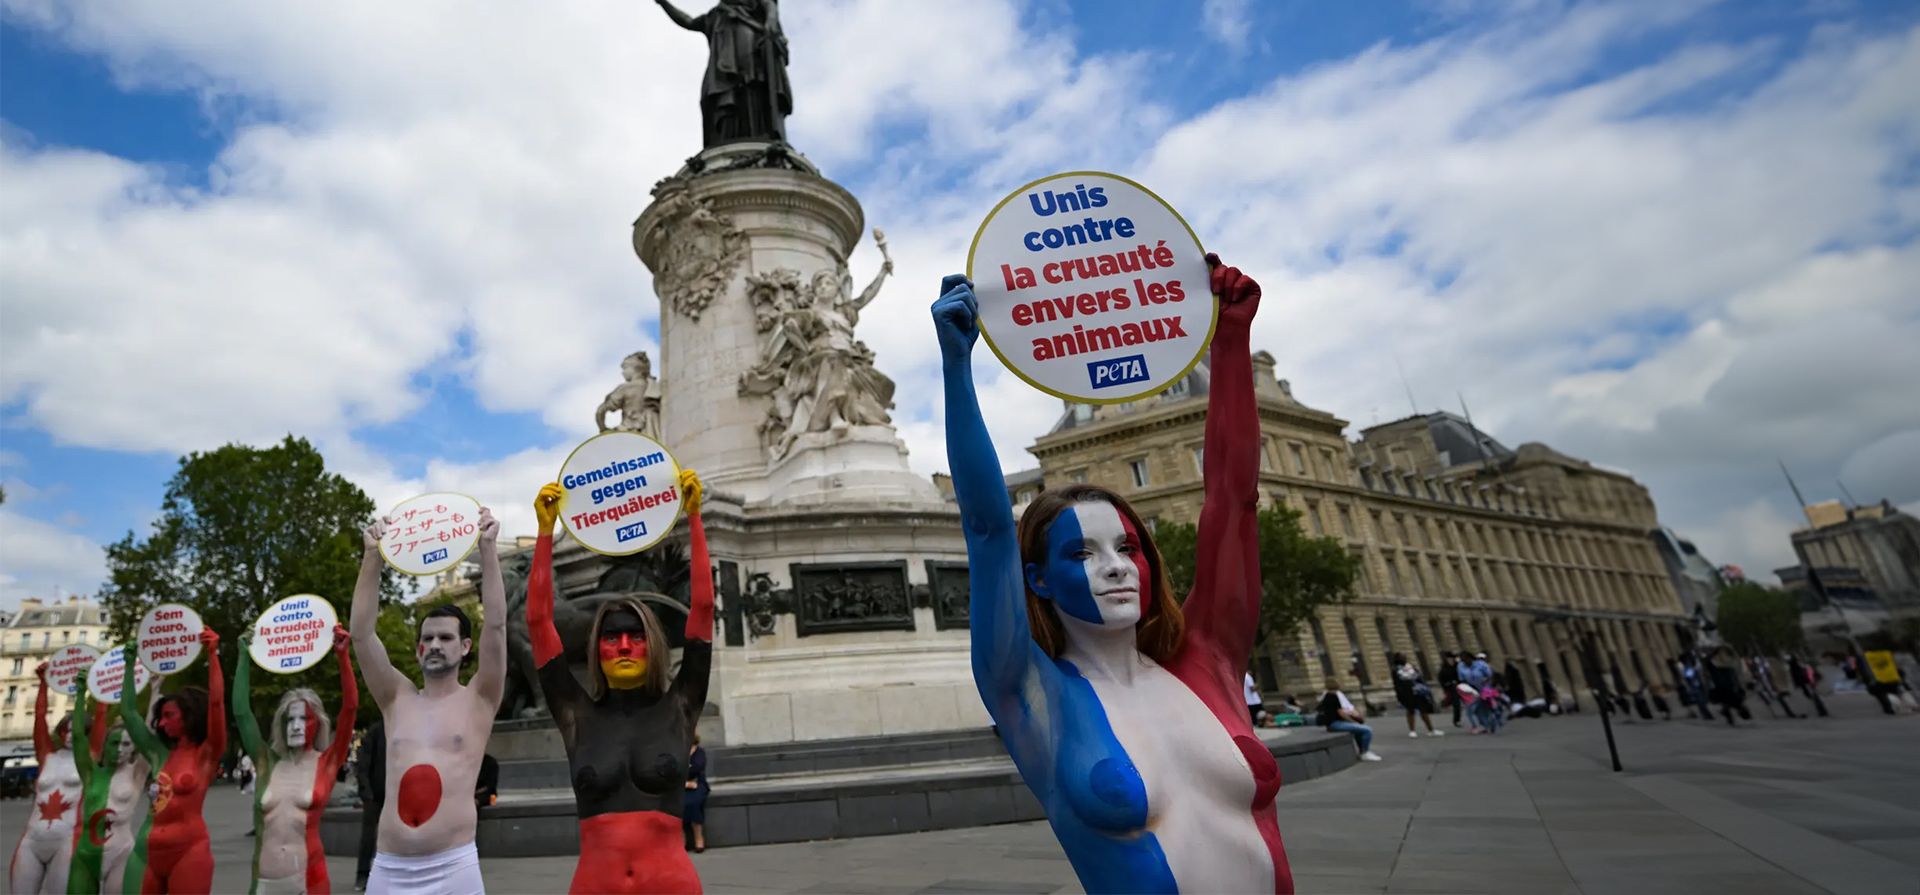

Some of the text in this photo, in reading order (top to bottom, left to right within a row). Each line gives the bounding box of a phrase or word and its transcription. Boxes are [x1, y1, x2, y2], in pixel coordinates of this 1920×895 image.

[1028, 184, 1108, 217] Unis
[1023, 216, 1135, 252] contre
[1000, 240, 1175, 291] la cruauté
[1011, 279, 1185, 326] envers les
[1031, 316, 1188, 361] animaux
[563, 451, 665, 490] Gemeinsam
[591, 475, 648, 504] gegen
[571, 486, 678, 530] Tierquälerei
[281, 600, 309, 611] Uniti
[155, 611, 183, 621] Sem
[273, 611, 313, 622] contro
[149, 623, 187, 634] couro,
[260, 619, 325, 636] la crudeltà
[142, 634, 196, 650] penas ou
[267, 630, 319, 645] verso gli
[152, 646, 187, 661] peles!
[268, 643, 314, 656] animali
